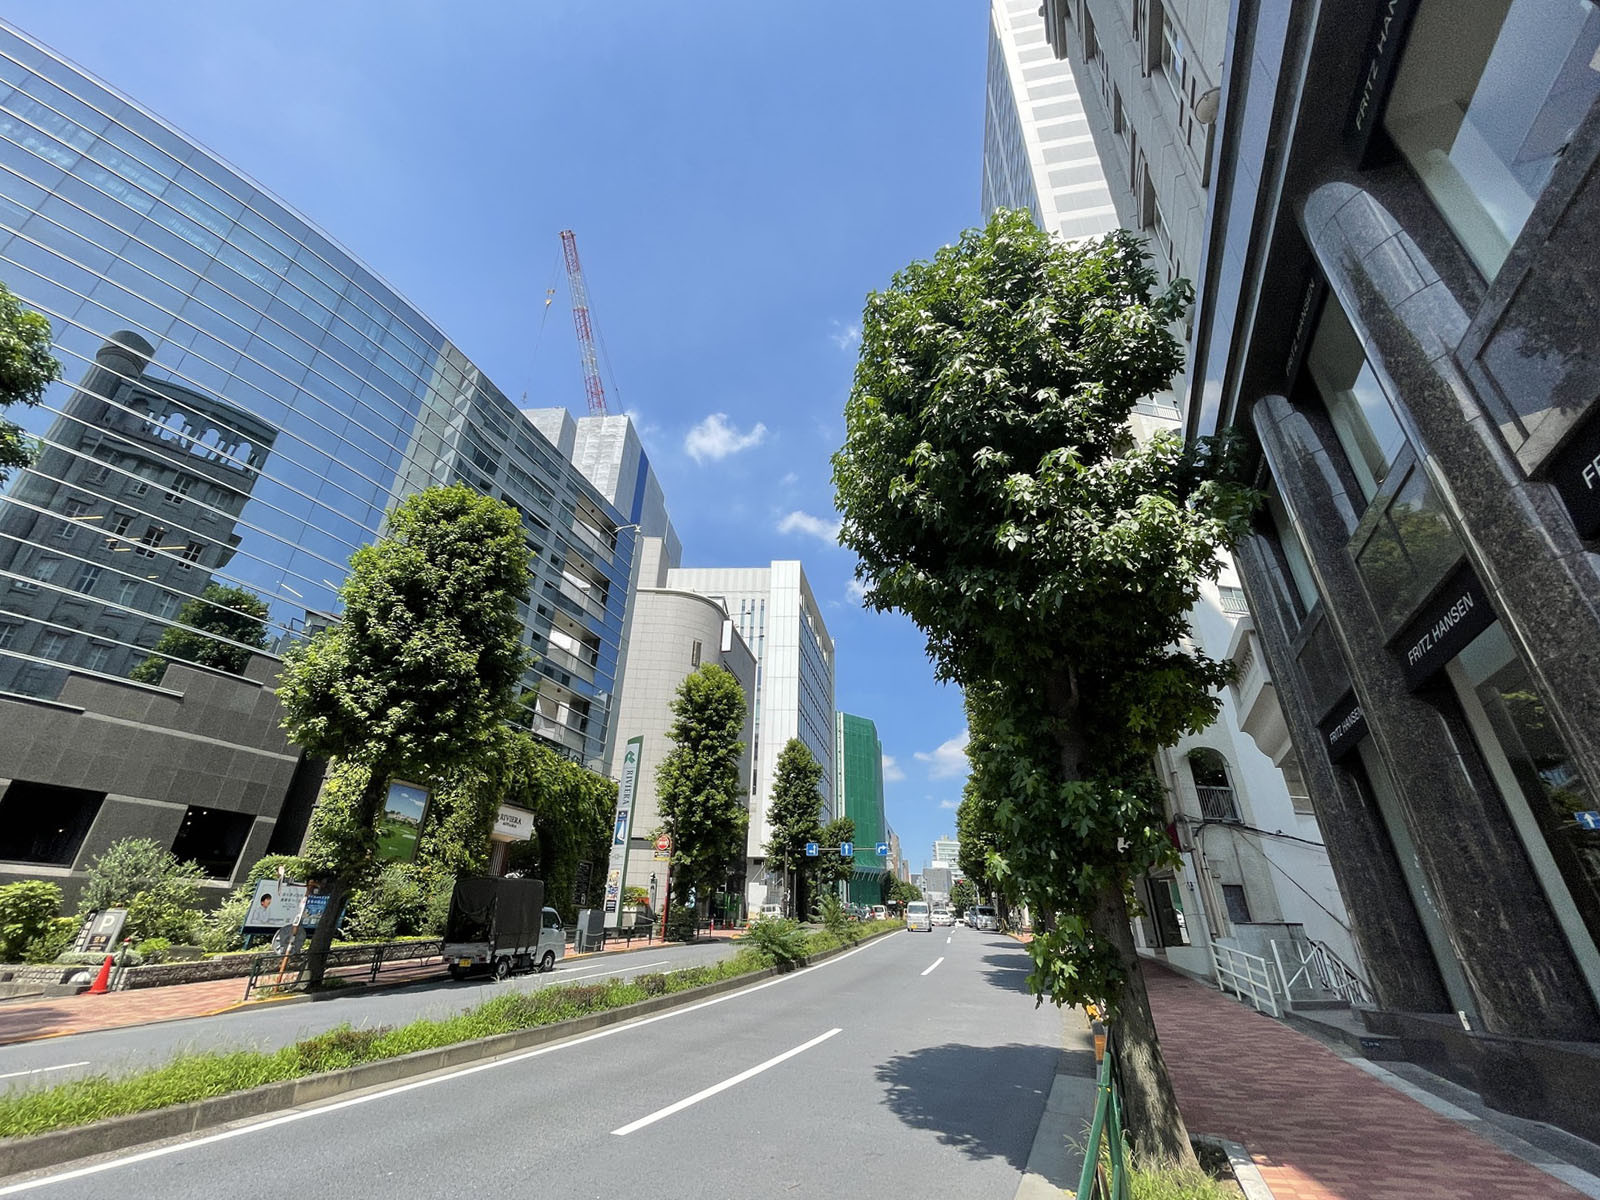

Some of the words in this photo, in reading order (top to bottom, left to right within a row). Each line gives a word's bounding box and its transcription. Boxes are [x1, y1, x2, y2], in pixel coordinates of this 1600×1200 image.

[1356, 59, 1379, 131] FRITZ
[1407, 633, 1433, 666] FRITZ
[1431, 591, 1474, 643] HANSEN
[1329, 725, 1343, 745] FRITZ
[622, 769, 634, 805] RIVIERA
[499, 813, 522, 825] RIVIERA
[98, 915, 115, 932] P
